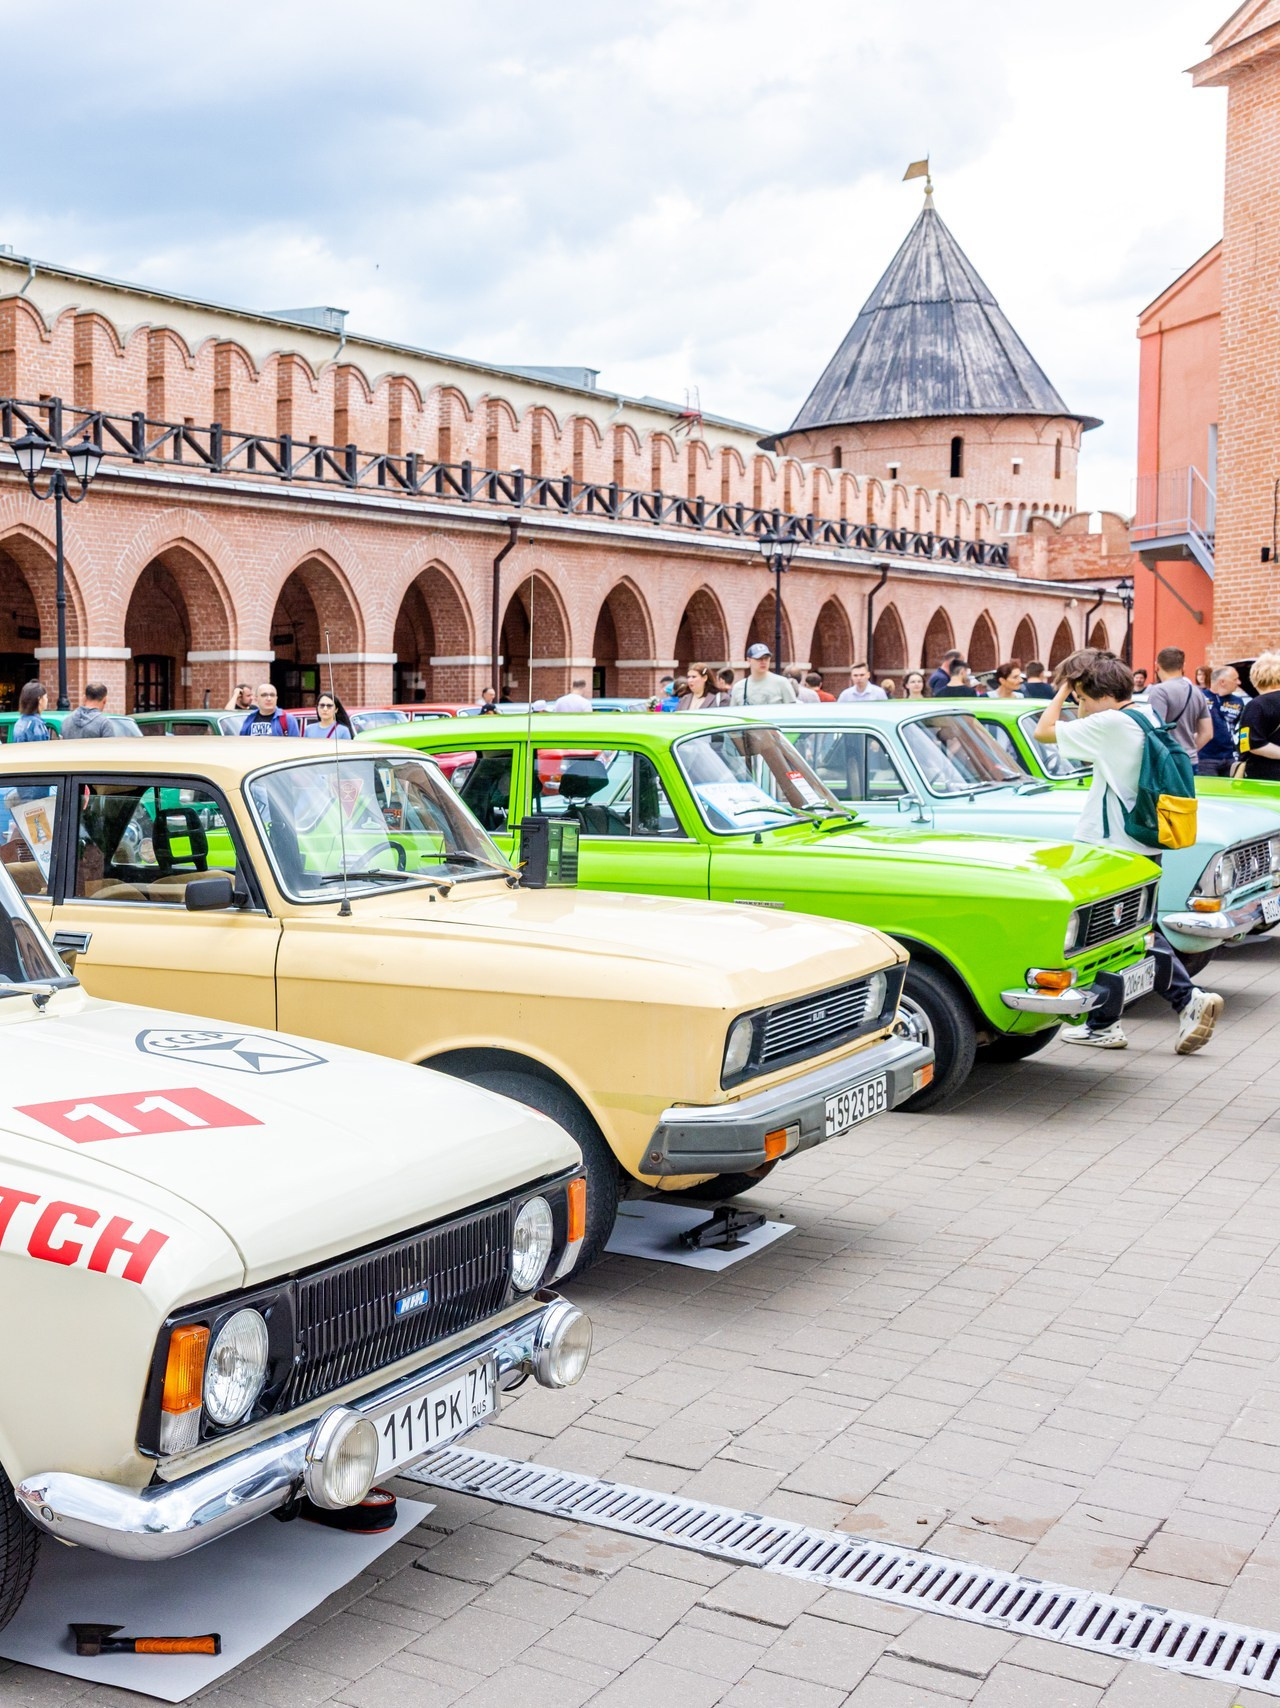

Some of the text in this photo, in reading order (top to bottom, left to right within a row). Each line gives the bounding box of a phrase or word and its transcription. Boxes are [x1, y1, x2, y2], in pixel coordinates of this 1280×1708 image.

[148, 1031, 223, 1049] СССР
[63, 1095, 211, 1134] 11
[838, 1087, 865, 1128] 5923
[868, 1080, 884, 1114] ВВ
[469, 1364, 488, 1404] 71
[472, 1400, 487, 1417] RUS
